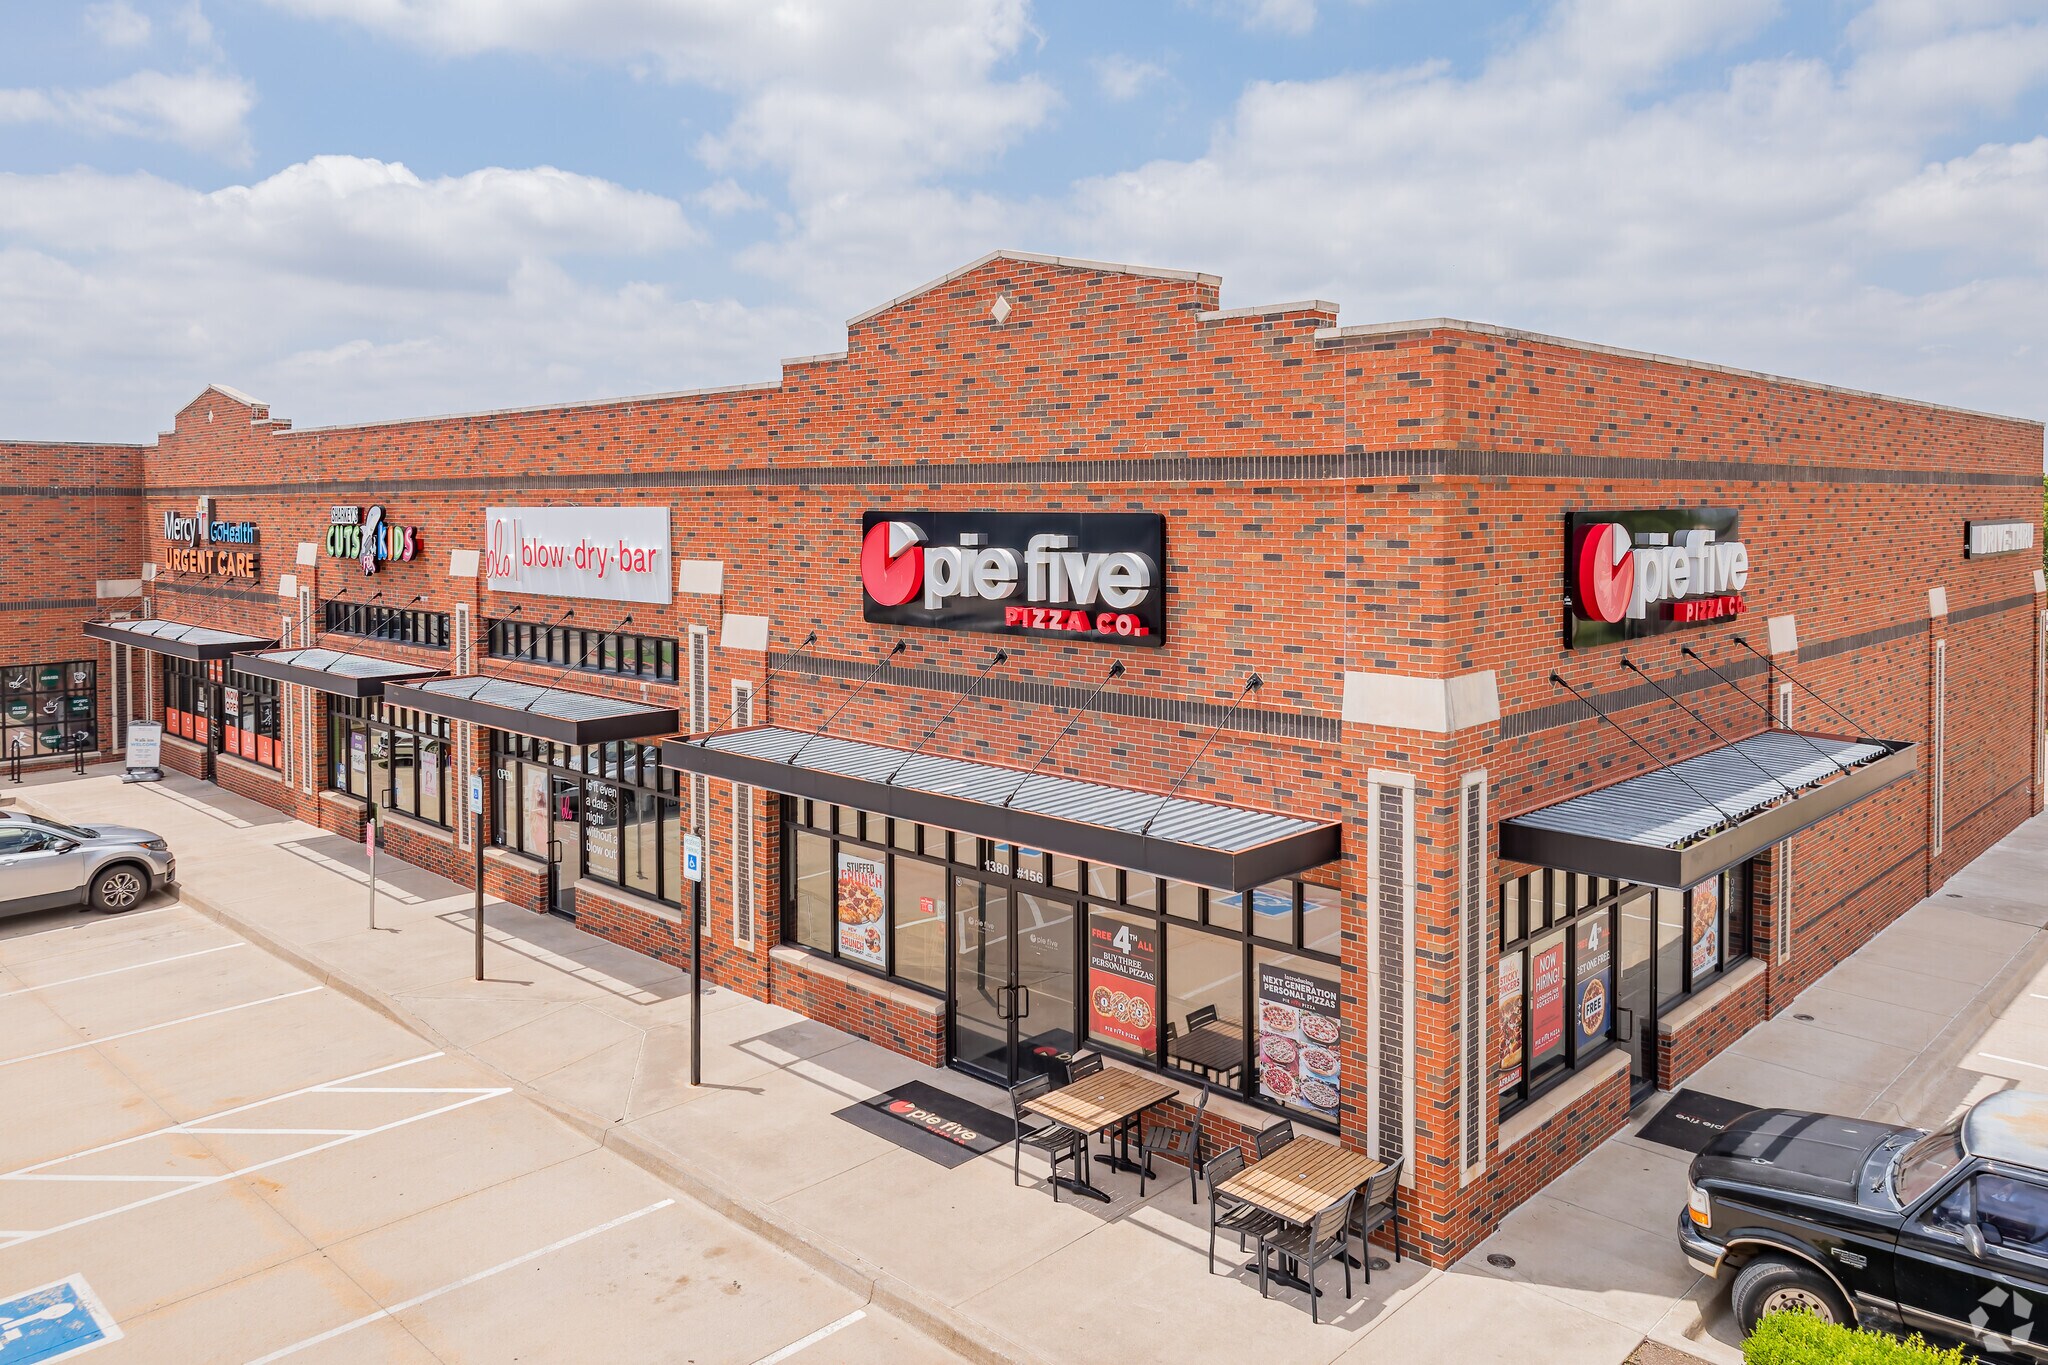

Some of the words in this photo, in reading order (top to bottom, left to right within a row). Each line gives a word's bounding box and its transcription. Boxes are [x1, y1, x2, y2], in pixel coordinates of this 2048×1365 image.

[164, 511, 196, 547] Mercy
[210, 521, 254, 543] GoHealth
[326, 525, 360, 559] CUTS
[377, 521, 413, 562] KIDS
[165, 547, 213, 574] URGENT
[217, 550, 254, 578] CARE
[924, 532, 1020, 609] pie
[1024, 533, 1152, 609] five
[1626, 532, 1690, 619] pie
[1674, 529, 1749, 592] five
[1005, 606, 1092, 632] PIZZA
[1096, 612, 1149, 636] CO.
[1685, 602, 1724, 622] PIZZA
[497, 768, 512, 781] OPEN
[599, 784, 617, 798] even
[585, 797, 590, 806] a
[592, 797, 611, 811] date
[585, 810, 604, 825] night
[585, 826, 612, 844] without
[586, 840, 603, 856] blow
[846, 862, 875, 874] STUFFED
[984, 860, 1009, 876] 1380
[1016, 867, 1043, 884] #156
[841, 869, 882, 889] CRUNCH
[841, 936, 864, 951] CRUNCH
[1092, 927, 1112, 941] FREE
[1137, 940, 1154, 953] ALL
[1092, 956, 1128, 974] PERSONAL
[1128, 967, 1154, 981] PIZZAS
[1103, 951, 1118, 962] BUY
[1118, 955, 1142, 969] THREE
[1539, 951, 1557, 974] NOW
[1586, 956, 1598, 971] ONE
[1597, 950, 1611, 966] FREE
[1262, 974, 1284, 986] NEXT
[1284, 981, 1337, 1000] GENERATION
[1284, 973, 1314, 987] Introducing
[1499, 969, 1519, 986] STICKY
[1535, 966, 1560, 993] HIRING!
[1264, 983, 1306, 1000] PERSONAL
[1306, 994, 1336, 1009] PIZZAS
[1301, 1002, 1316, 1010] PIZZA
[1119, 1003, 1124, 1011] 2
[1136, 1008, 1141, 1017] 3
[1585, 997, 1602, 1017] FREE
[1125, 1032, 1140, 1041] PIZZA
[906, 1109, 941, 1125] pie
[939, 1121, 977, 1140] five
[1675, 1113, 1700, 1124] five
[1702, 1121, 1725, 1130] pie
